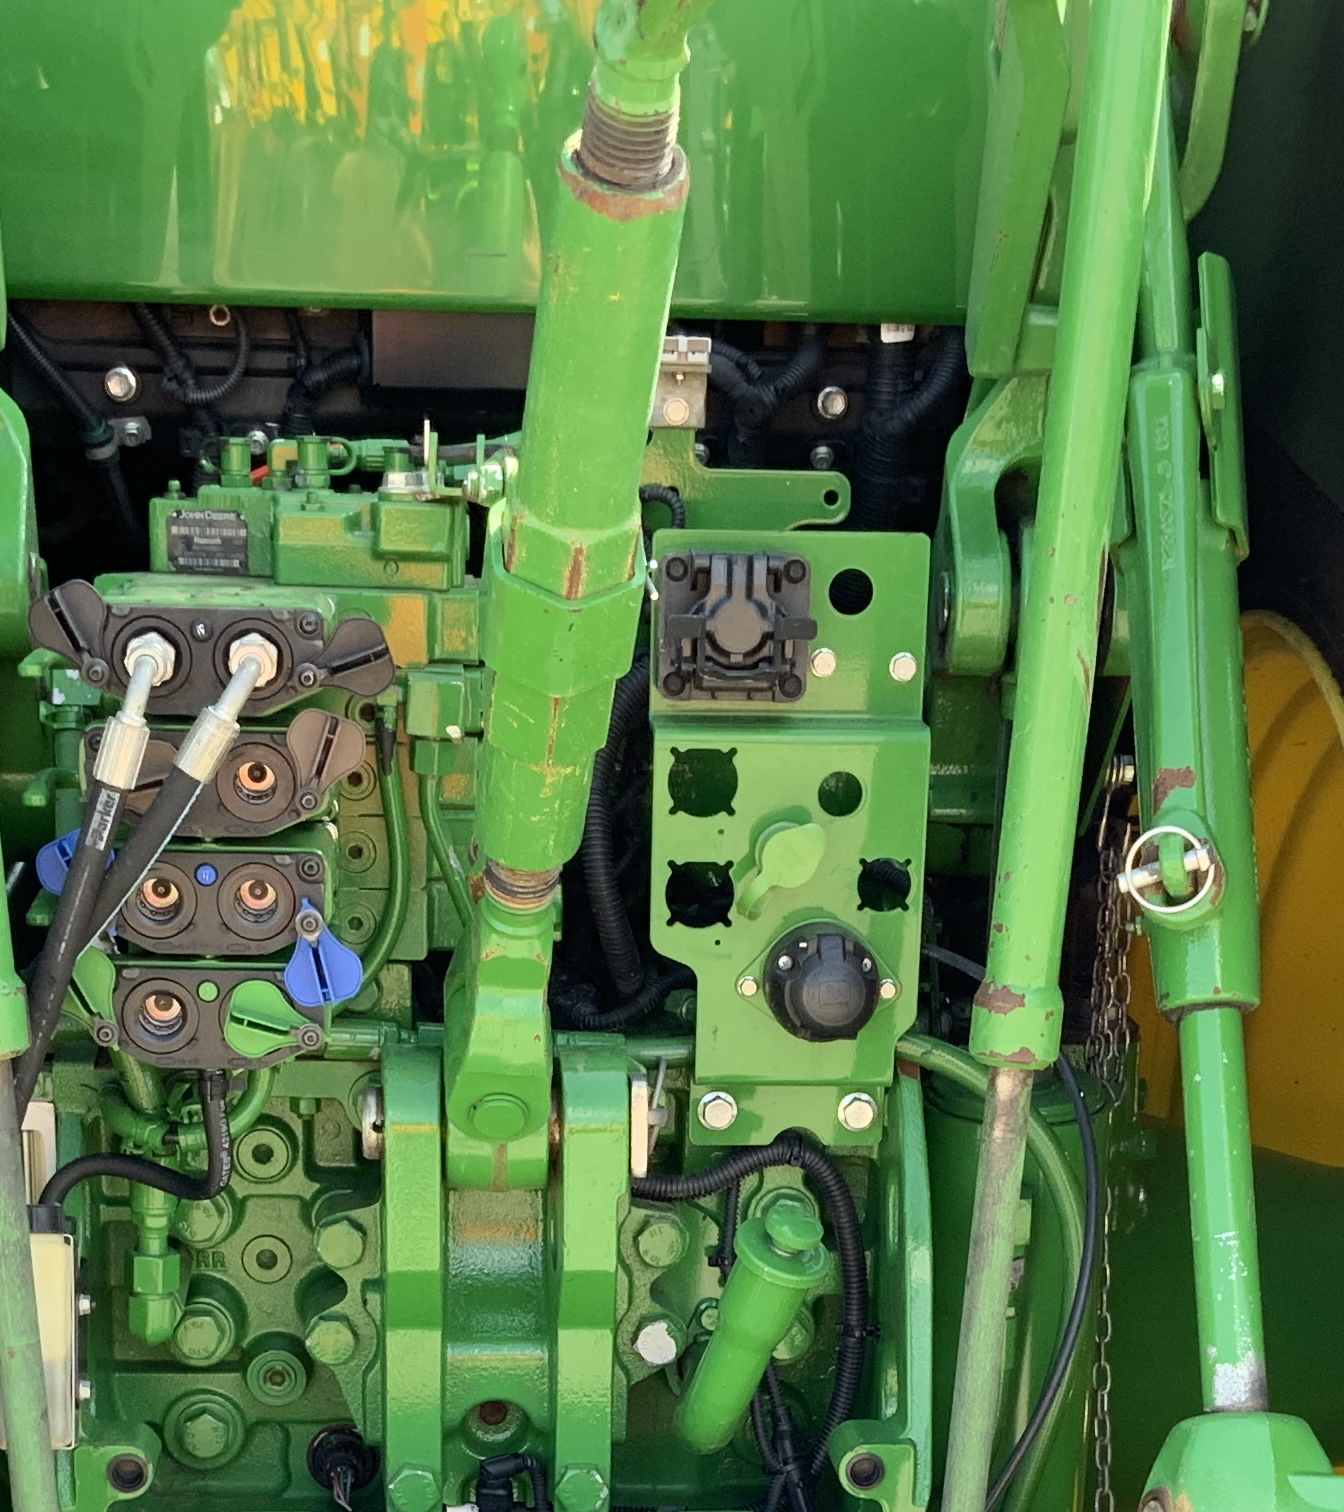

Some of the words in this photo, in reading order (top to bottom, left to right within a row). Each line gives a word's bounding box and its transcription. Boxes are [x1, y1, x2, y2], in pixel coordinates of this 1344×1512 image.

[179, 510, 204, 519] JOHN
[205, 511, 237, 521] DEERE
[90, 793, 116, 846] Parker
